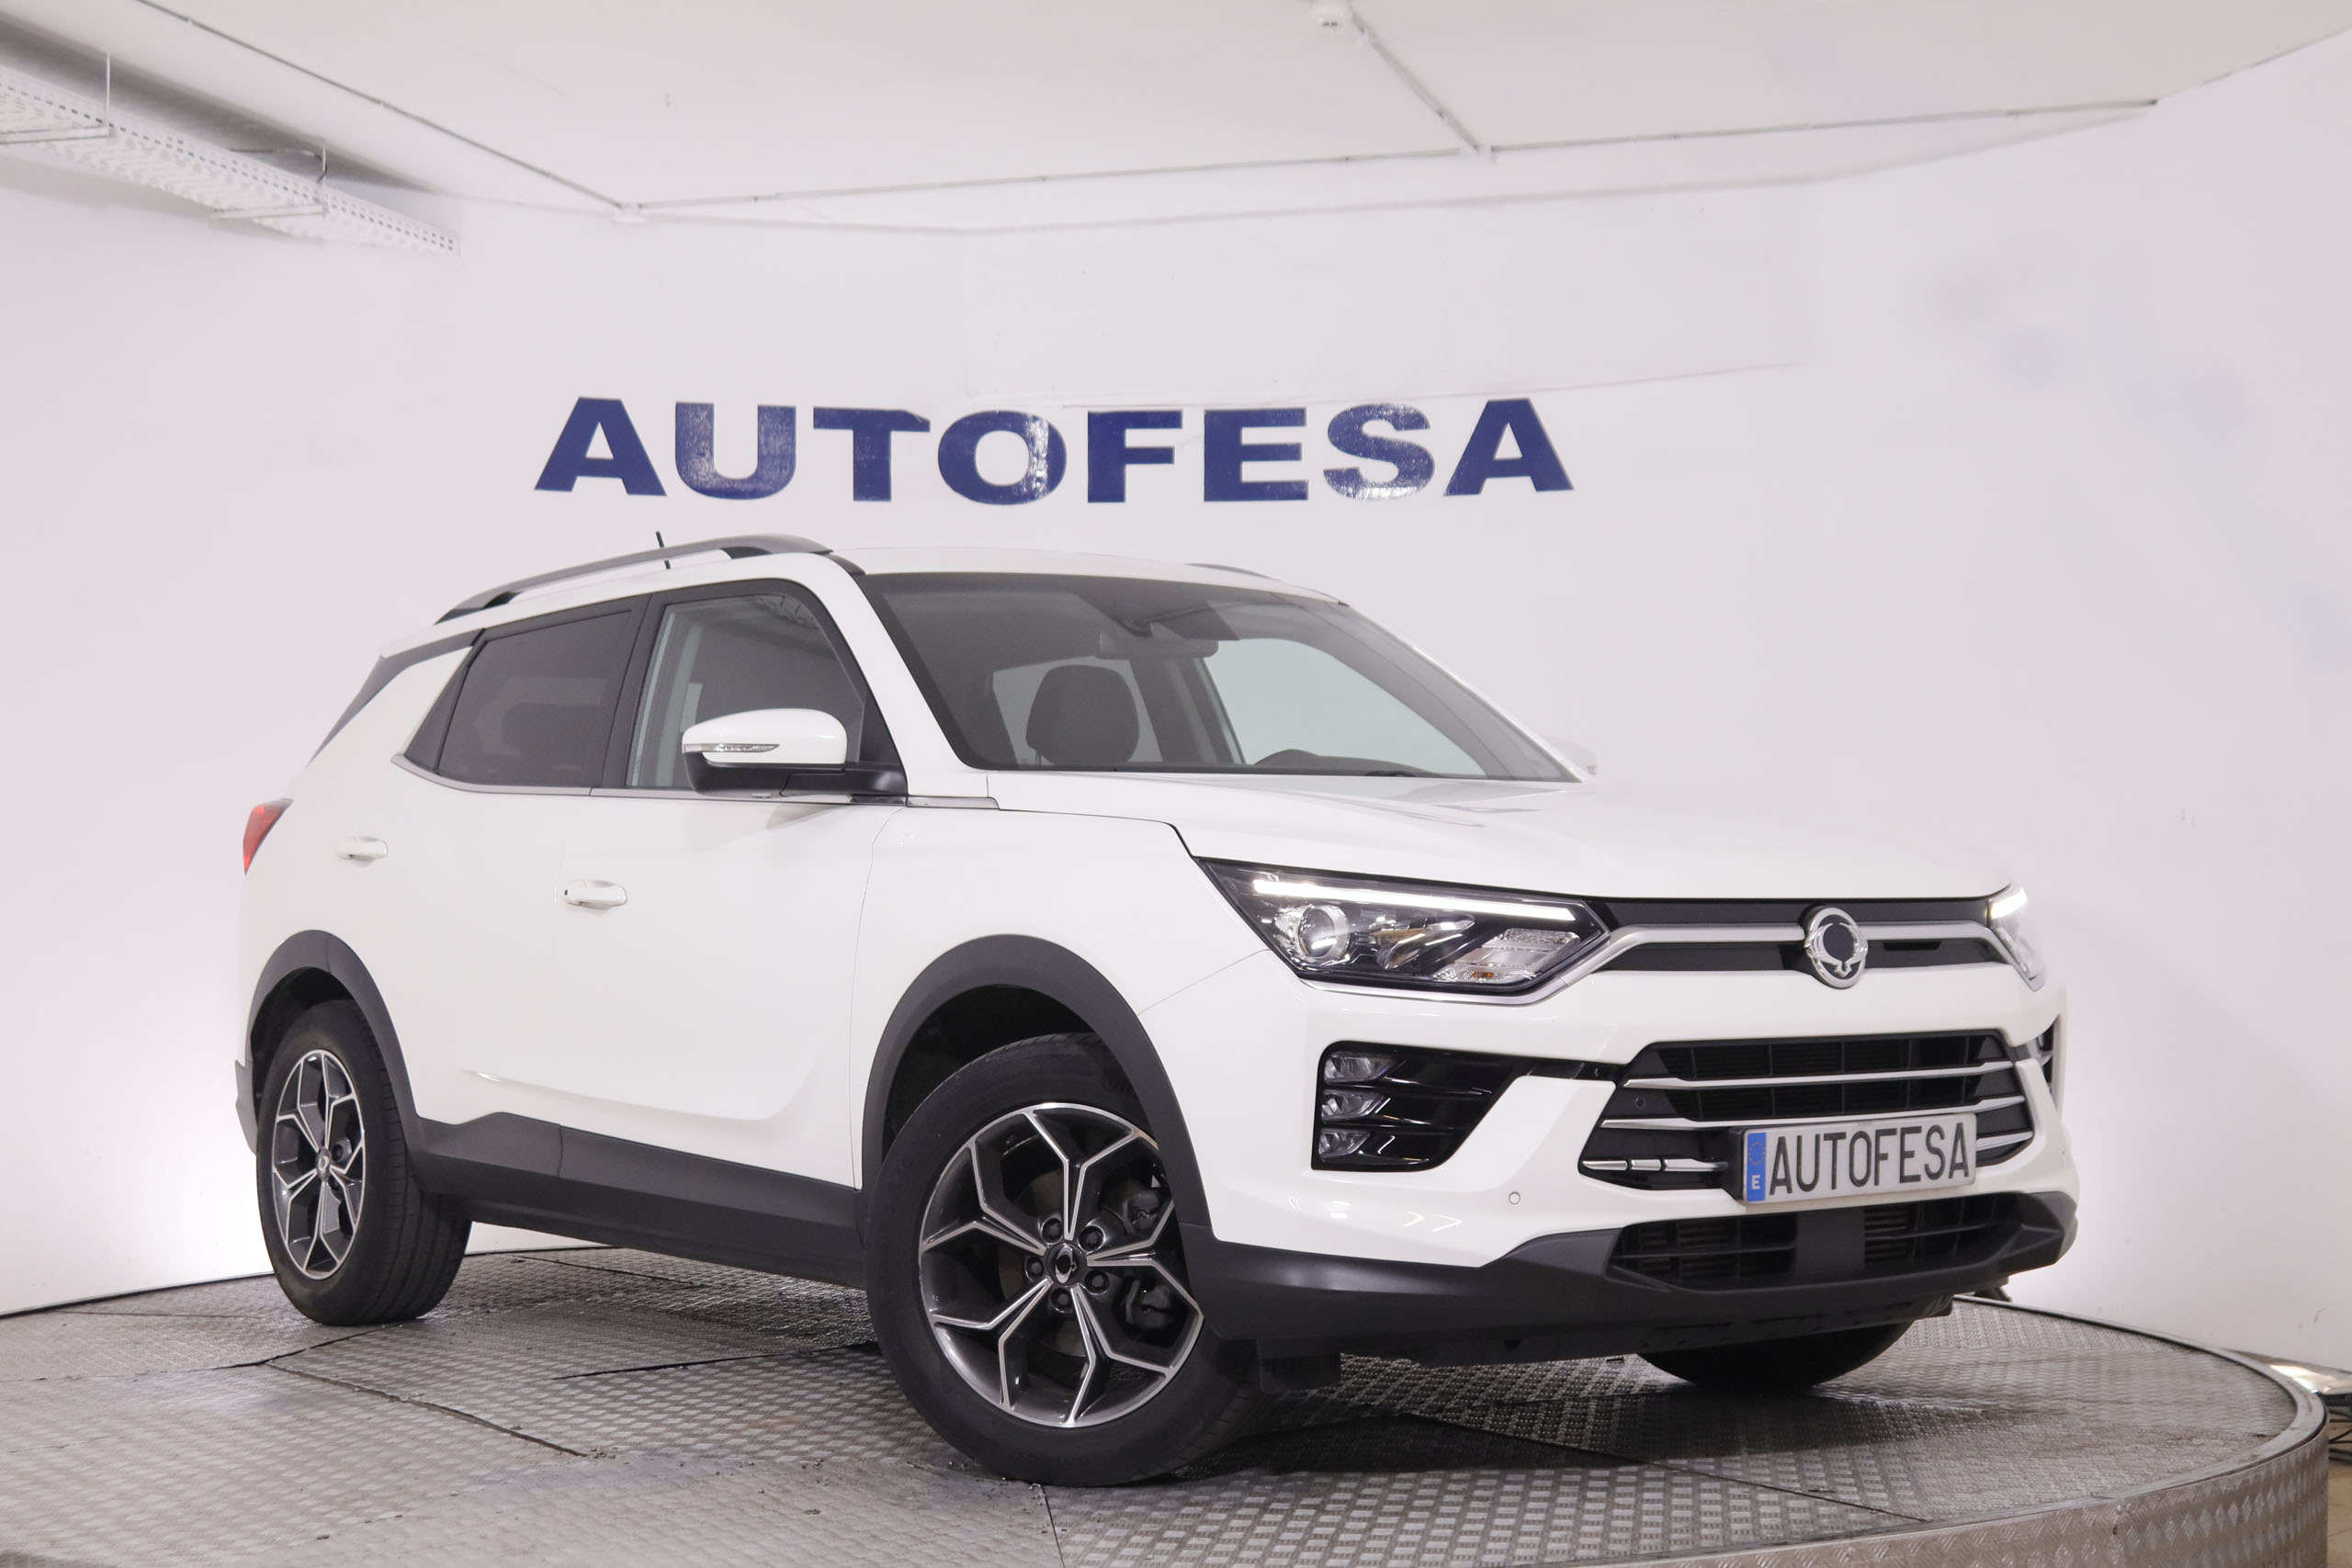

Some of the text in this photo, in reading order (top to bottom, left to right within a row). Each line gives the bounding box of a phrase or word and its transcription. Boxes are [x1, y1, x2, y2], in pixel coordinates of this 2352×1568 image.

[534, 396, 1574, 505] AUTOFESA
[1751, 1174, 1761, 1190] E
[1770, 1122, 1970, 1196] AUTOFESA
